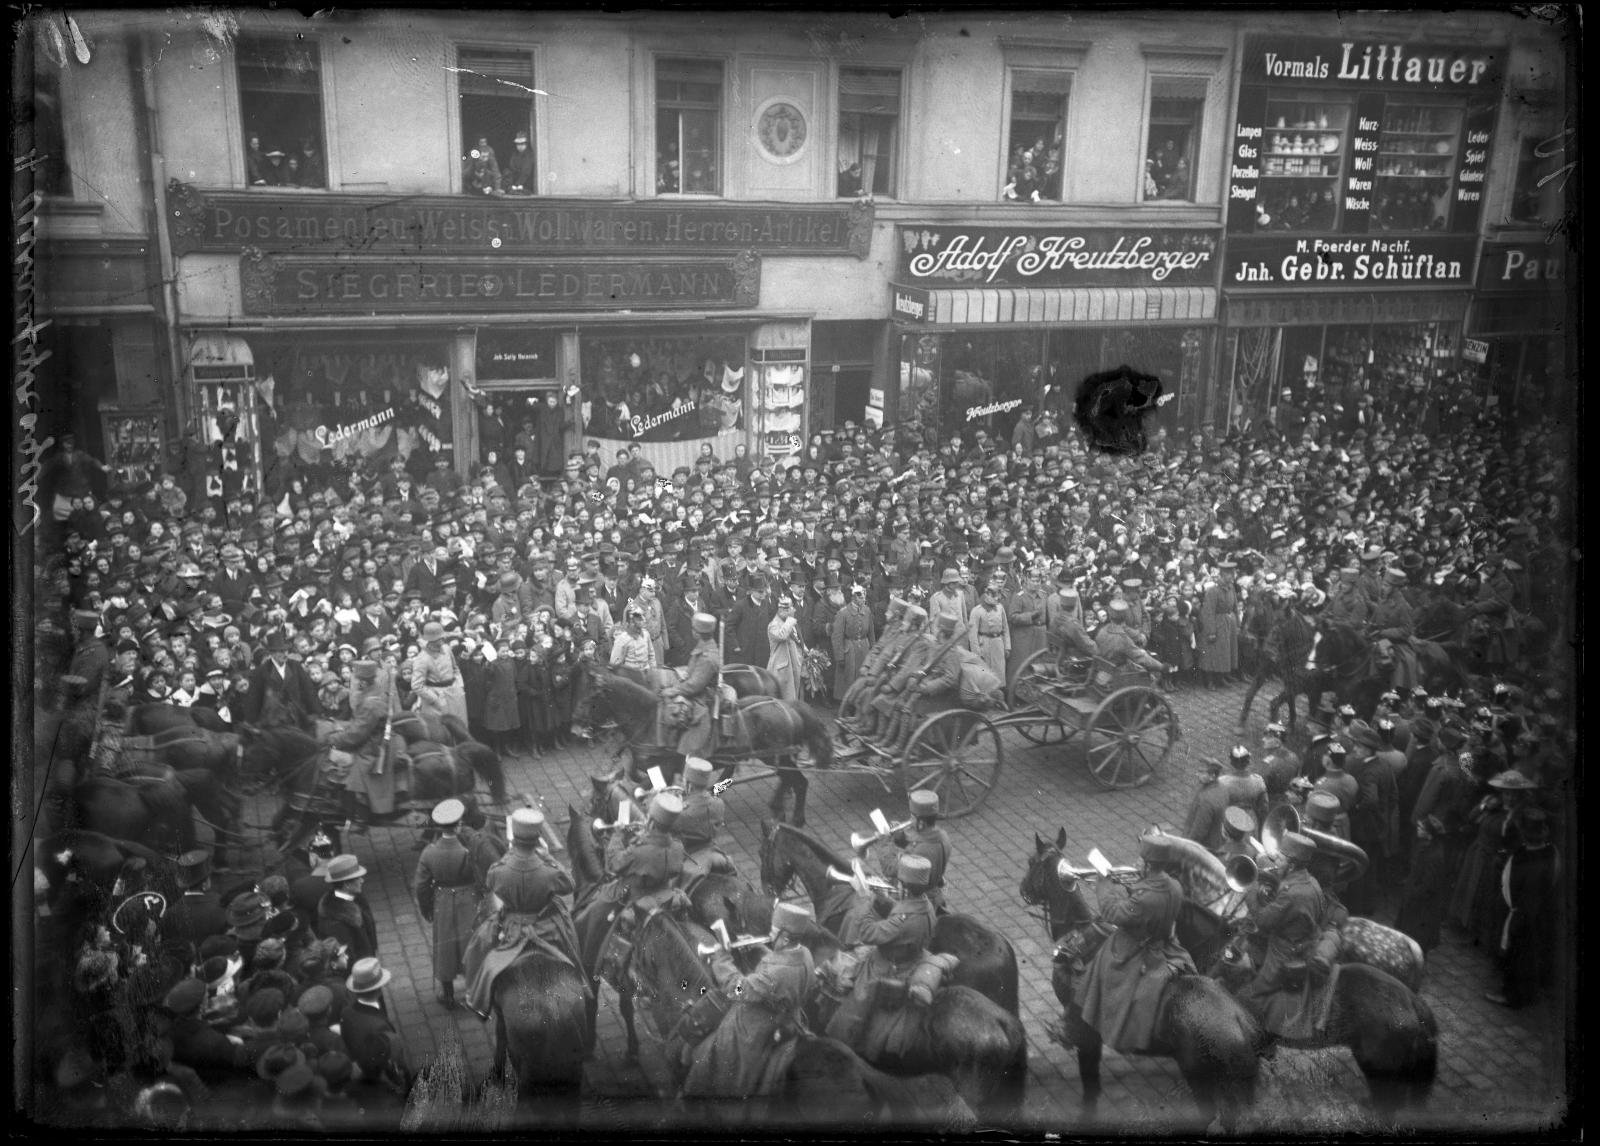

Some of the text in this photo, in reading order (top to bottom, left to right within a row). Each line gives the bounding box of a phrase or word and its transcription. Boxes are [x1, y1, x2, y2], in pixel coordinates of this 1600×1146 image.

[1265, 43, 1486, 84] Vormals Littauer
[1237, 123, 1262, 140] Lampen
[1238, 144, 1257, 158] Glas
[1349, 177, 1372, 191] Waren
[1458, 188, 1480, 201] Waren
[1296, 240, 1411, 253] M. Foerder Nachf.
[909, 235, 1210, 283] Adolf Kreutzberger
[1281, 256, 1345, 281] Gebr.
[1353, 255, 1461, 280] Schüftan
[515, 269, 721, 298] LEDERMANN
[630, 400, 696, 438] Ledermann
[966, 399, 1022, 421] Kreutzberger
[314, 407, 395, 449] Ledermann
